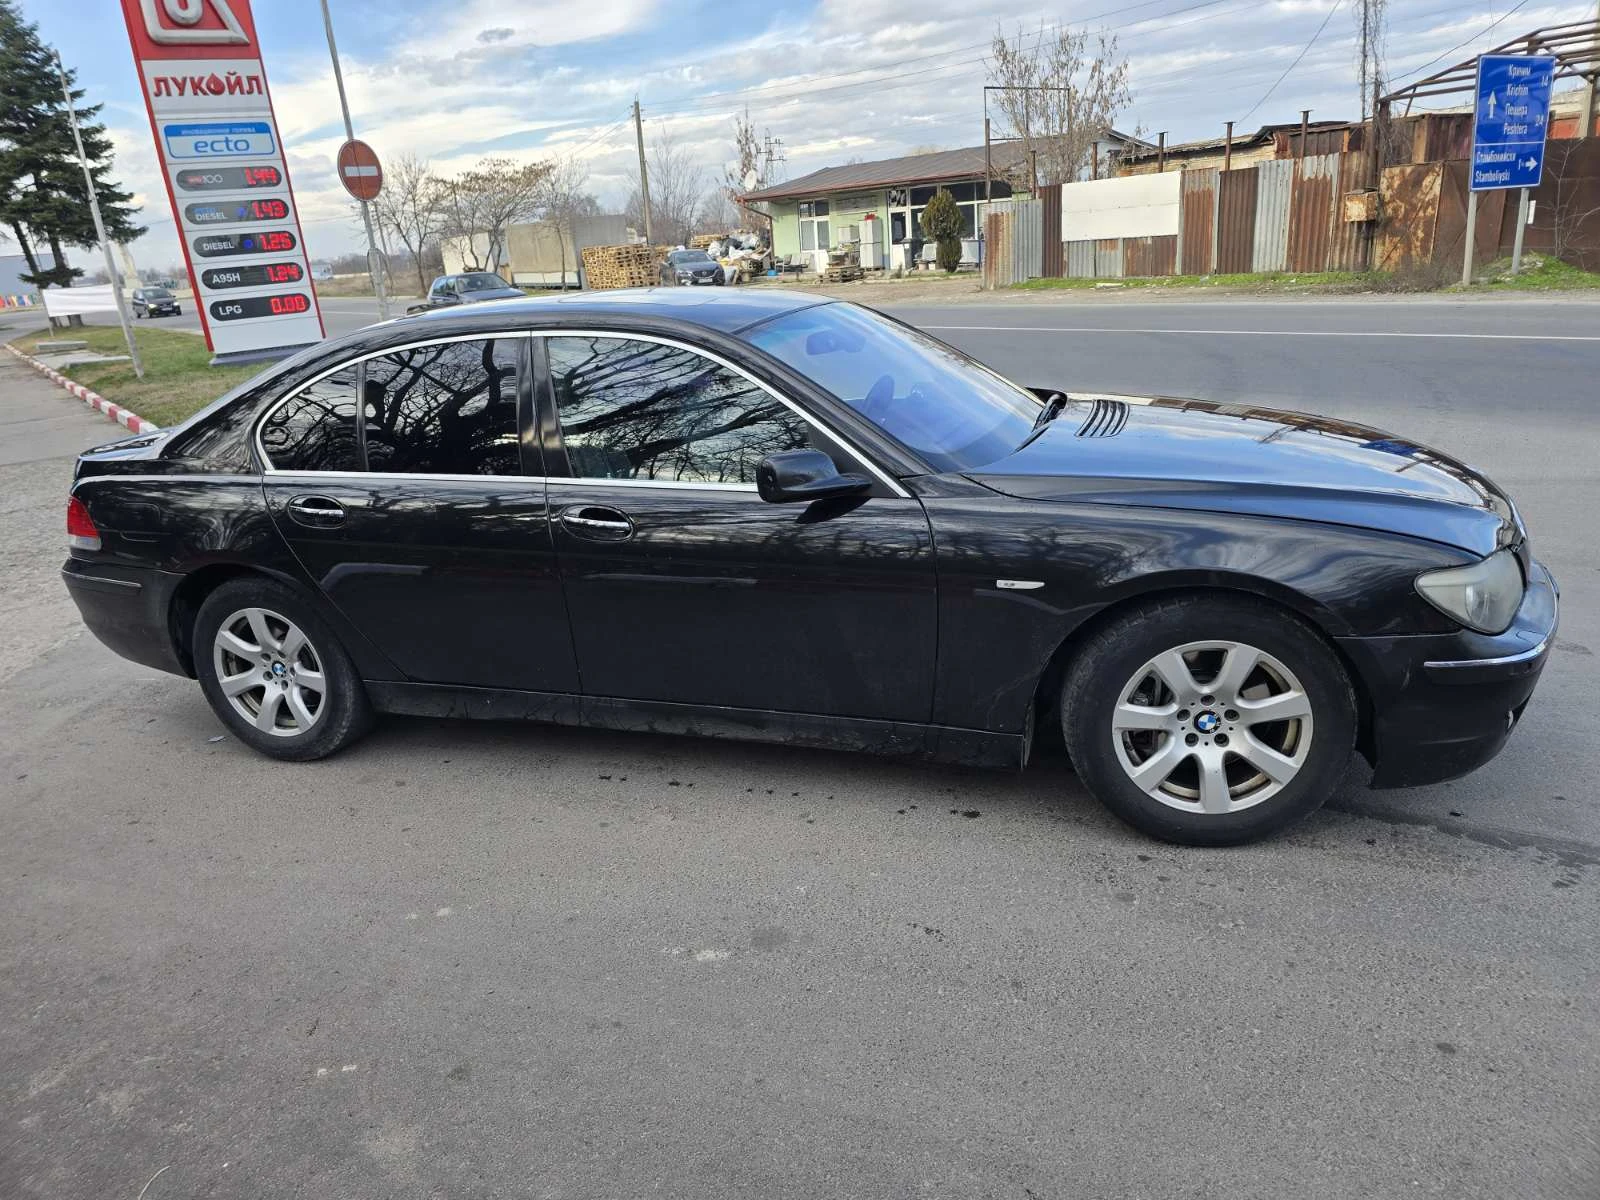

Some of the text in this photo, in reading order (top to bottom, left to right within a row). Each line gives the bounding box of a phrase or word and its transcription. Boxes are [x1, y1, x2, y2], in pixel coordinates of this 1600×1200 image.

[153, 72, 264, 97] ЛУКОЙЛ
[194, 136, 250, 153] ecto
[195, 211, 228, 221] DIESEL
[203, 241, 235, 251] DIESEL
[218, 305, 243, 316] LPG
